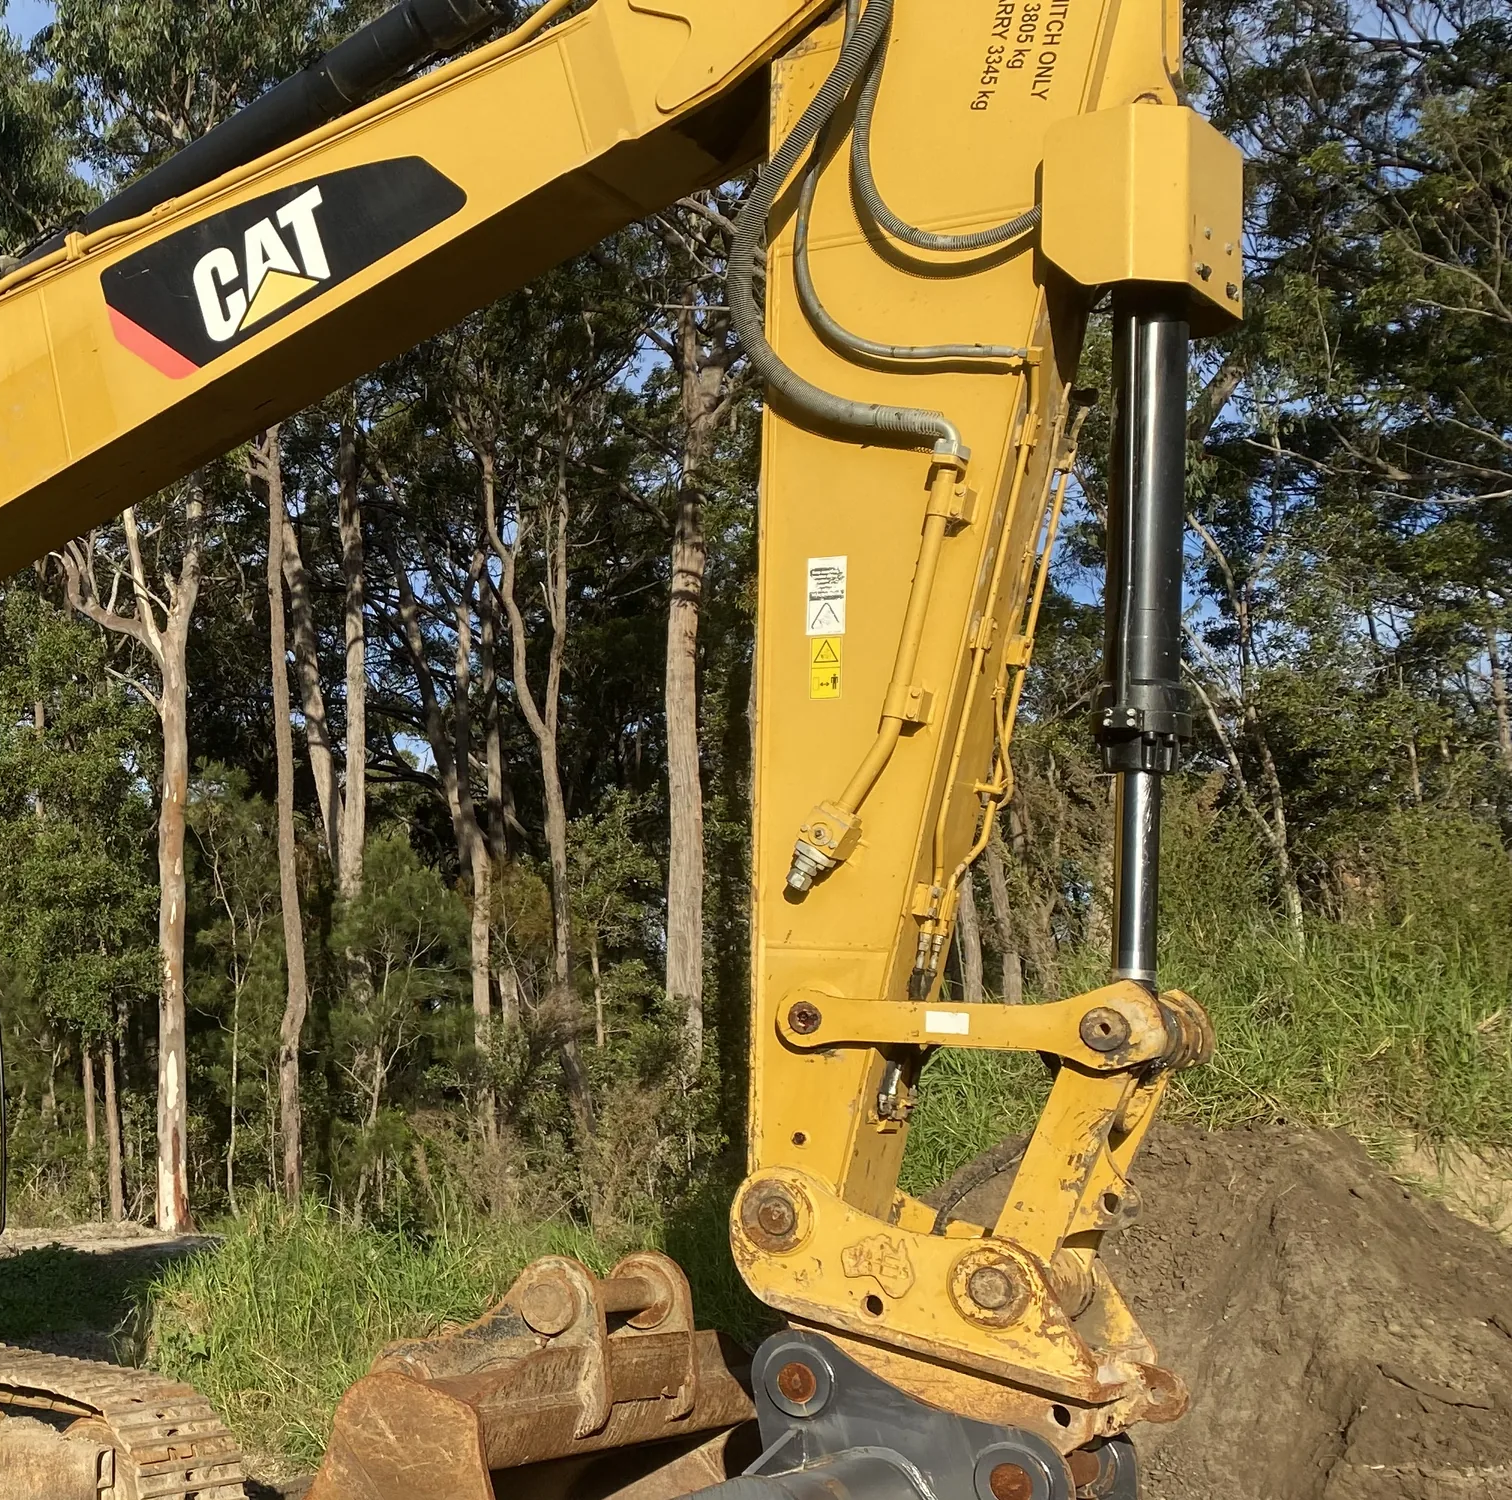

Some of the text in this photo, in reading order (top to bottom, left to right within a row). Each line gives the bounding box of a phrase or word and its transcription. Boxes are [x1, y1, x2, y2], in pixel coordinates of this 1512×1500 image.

[970, 0, 1015, 111] RRY 3345 kg
[1006, 3, 1041, 69] 3805 kg
[1030, 0, 1069, 101] ITCH ONLY
[192, 184, 332, 342] CAT
